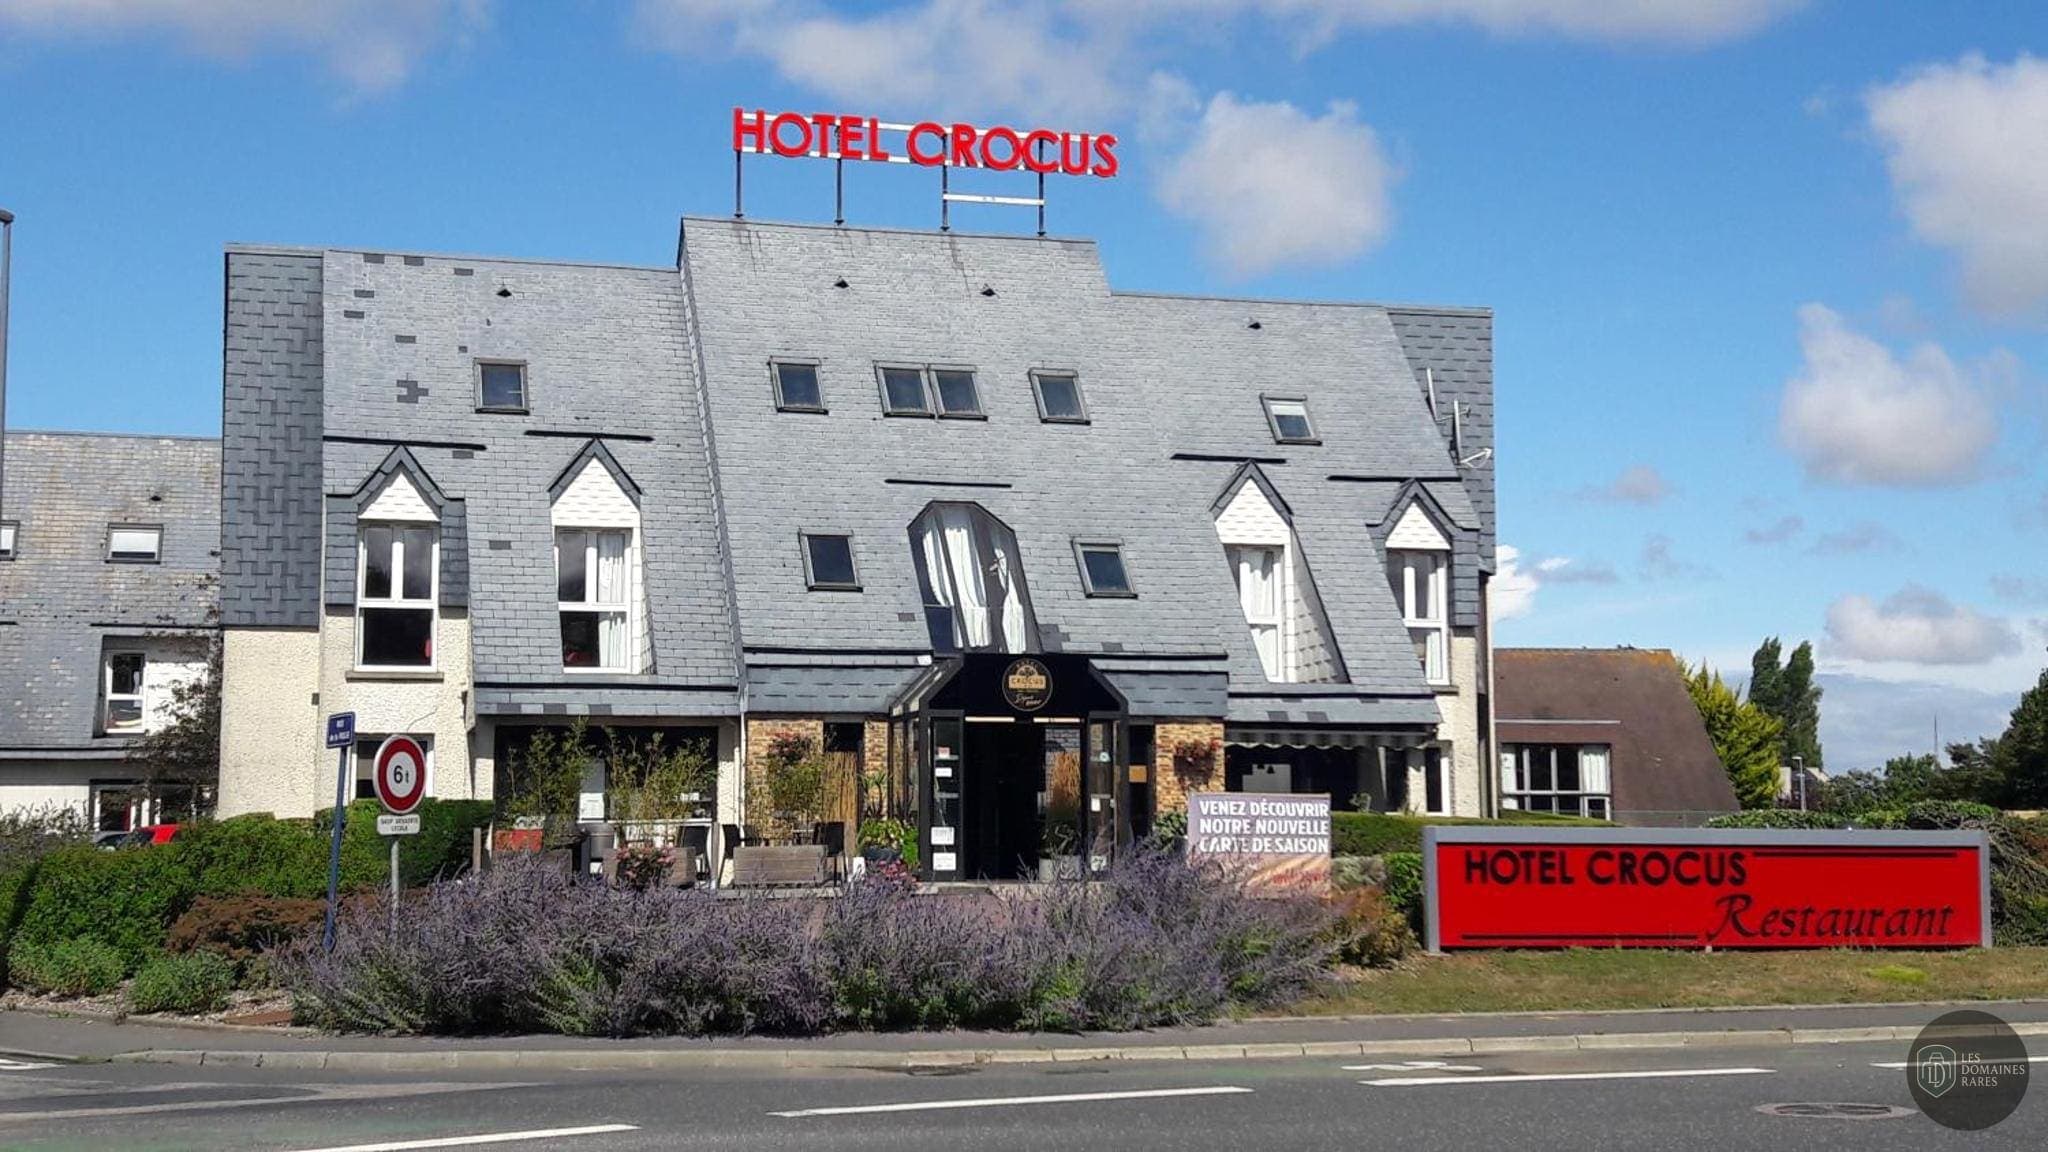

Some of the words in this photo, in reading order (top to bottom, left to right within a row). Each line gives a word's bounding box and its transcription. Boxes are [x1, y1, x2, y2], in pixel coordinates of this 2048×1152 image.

[733, 107, 889, 161] HOTEL
[906, 121, 1119, 177] CROCUS
[393, 765, 404, 784] 6
[405, 770, 410, 784] t
[1200, 800, 1246, 816] VENEZ
[1250, 798, 1329, 817] DÉCOUVRIR
[1200, 818, 1250, 834] NOTRE
[1255, 818, 1329, 835] NOUVELLE
[1200, 836, 1249, 852] CARTE
[1252, 837, 1273, 852] DE
[1275, 837, 1329, 853] SAISON
[1464, 850, 1574, 885] HOTEL
[1587, 850, 1747, 886] CROCUS
[1706, 893, 1956, 941] Restaurant
